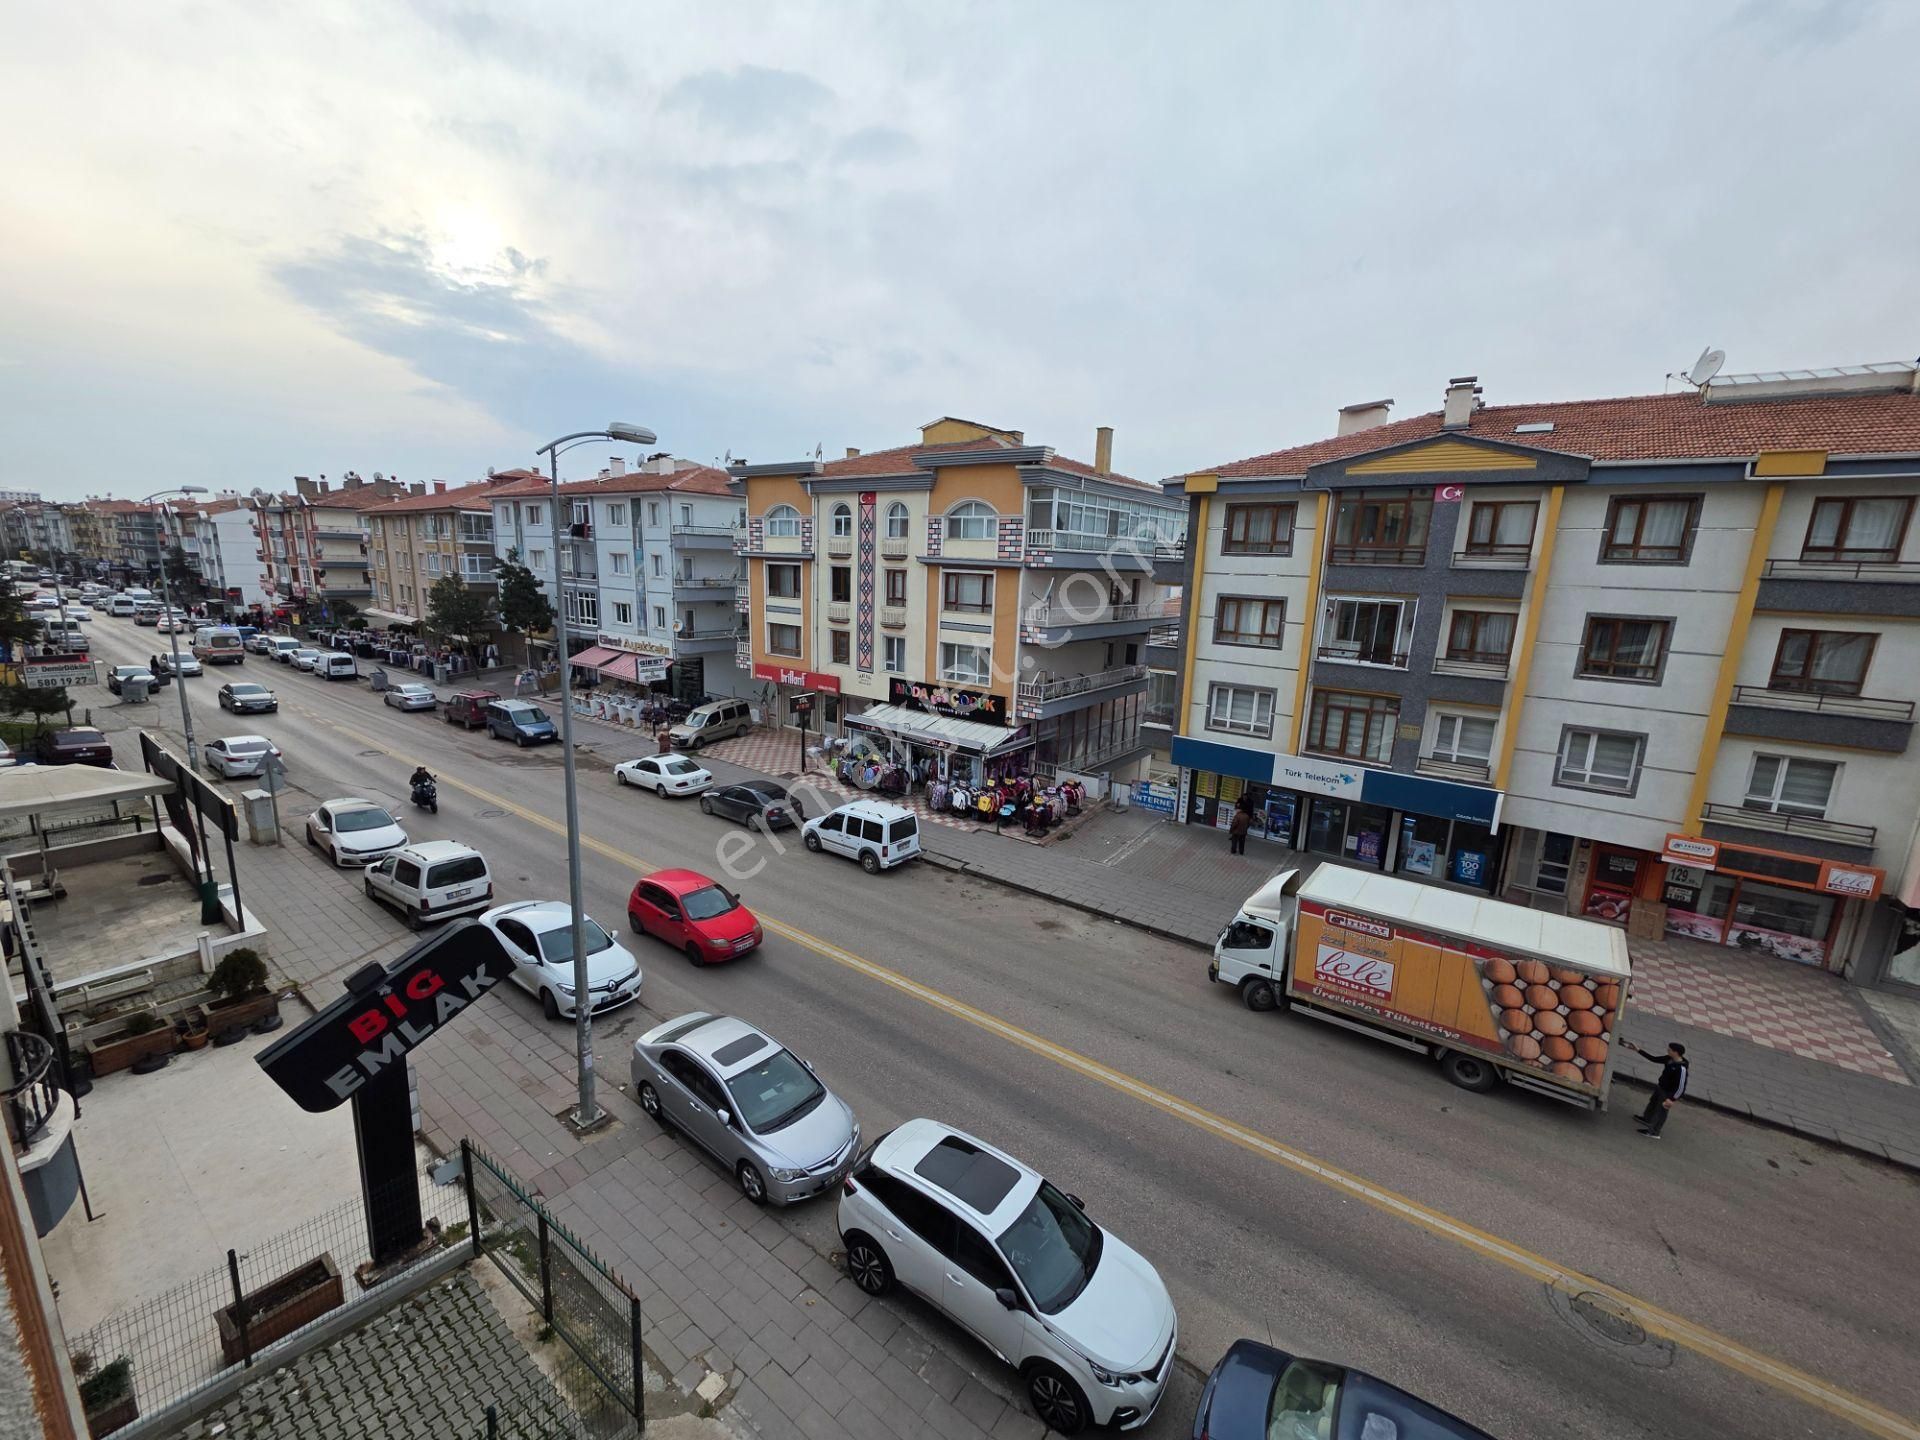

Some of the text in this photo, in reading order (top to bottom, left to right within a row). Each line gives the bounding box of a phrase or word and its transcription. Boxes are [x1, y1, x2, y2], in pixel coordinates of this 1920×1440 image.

[37, 676, 87, 687] 580 19 27
[895, 682, 929, 700] MODA
[1285, 768, 1340, 784] Türk Telekom
[1461, 860, 1479, 870] 100
[1316, 951, 1388, 986] lele
[1318, 974, 1386, 998] yumurta
[322, 962, 498, 1100] EMLAK
